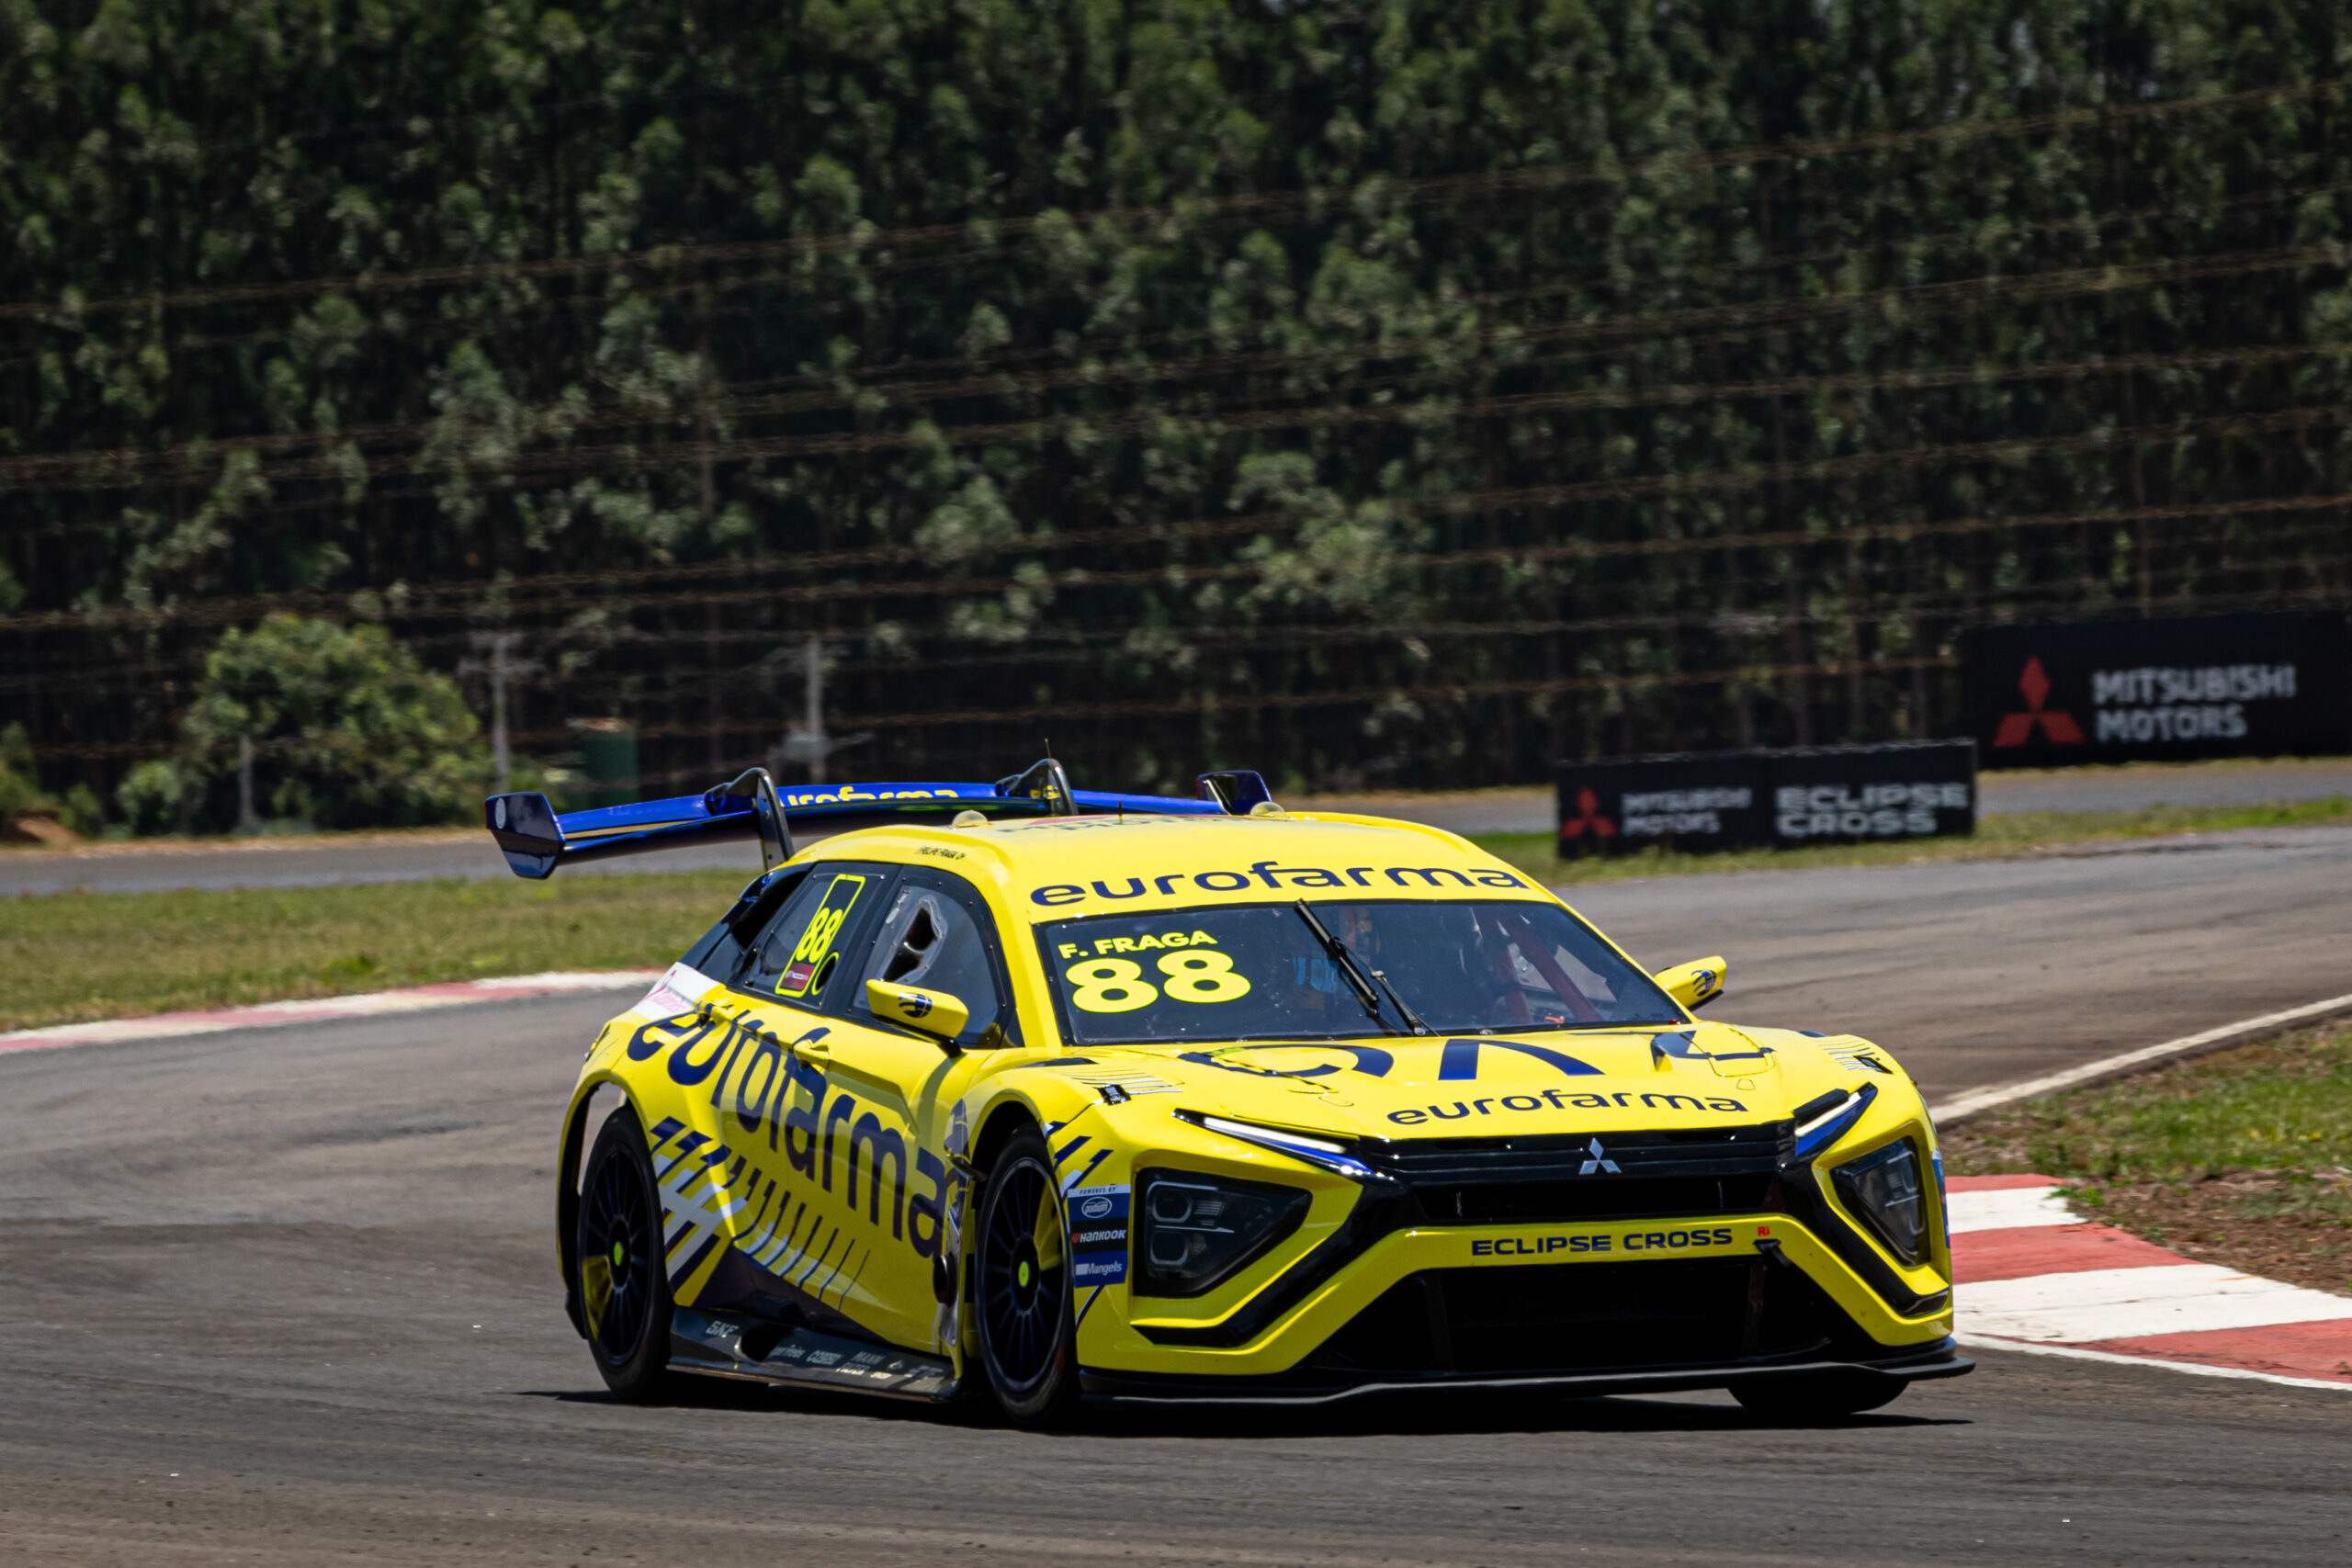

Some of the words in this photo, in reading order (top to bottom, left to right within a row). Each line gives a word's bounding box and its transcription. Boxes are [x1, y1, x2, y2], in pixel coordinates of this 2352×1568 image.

[2093, 666, 2296, 704] MITSUBISHI
[2096, 706, 2247, 741] MOTORS
[1775, 784, 1968, 810] ECLIPSE
[1775, 809, 1937, 837] CROSS
[1030, 861, 1531, 906] eurofarma
[796, 908, 843, 963] 88
[1058, 943, 1089, 959] F.
[1094, 930, 1218, 954] FRAGA
[1066, 949, 1251, 1013] 88
[1387, 1089, 1748, 1124] eurofarma
[627, 998, 946, 1258] eurofarma
[1472, 1235, 1611, 1256] ECLIPSE
[1623, 1228, 1733, 1250] CROSS
[1088, 1260, 1123, 1276] Mangels
